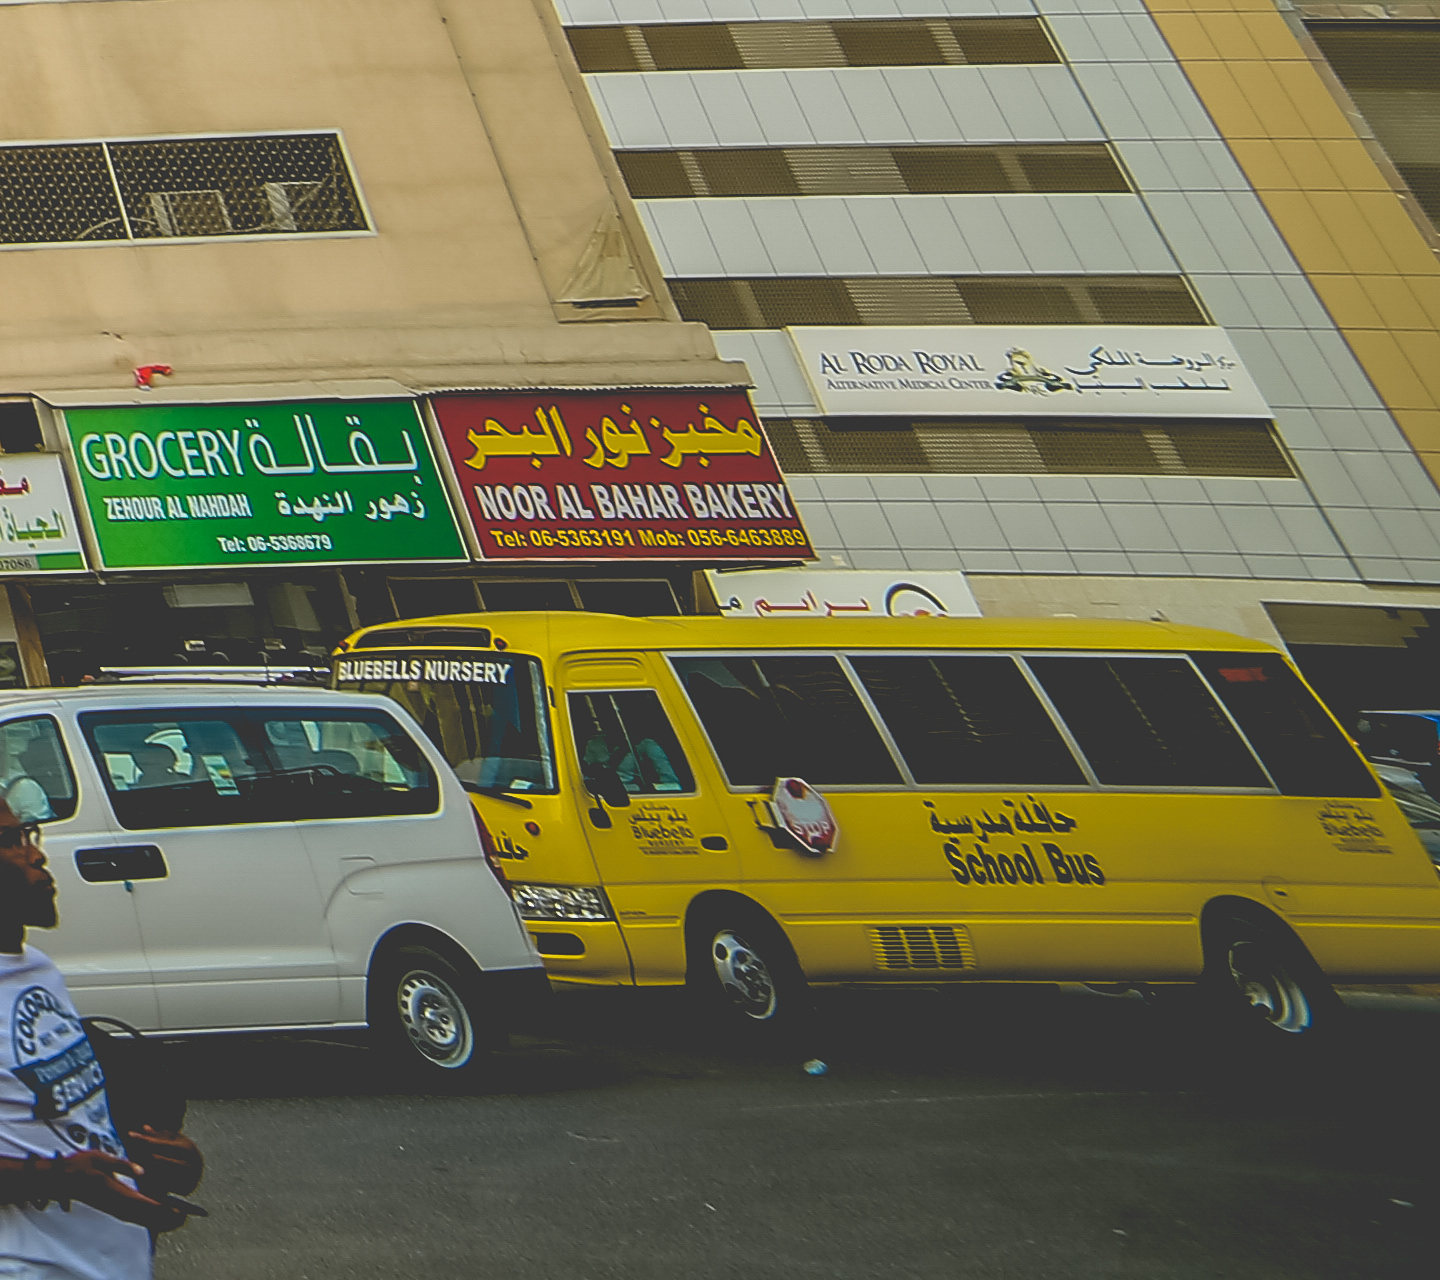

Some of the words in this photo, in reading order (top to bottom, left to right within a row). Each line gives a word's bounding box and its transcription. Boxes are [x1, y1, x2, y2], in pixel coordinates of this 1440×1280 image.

[82, 429, 244, 478] GROCERY
[244, 413, 424, 485] بقالة
[464, 405, 571, 470] البحر
[583, 403, 651, 468] نور
[650, 403, 762, 468] مخبز
[104, 496, 166, 520] ZEHOUR
[166, 496, 188, 519] AL
[188, 494, 252, 518] NAHDAH
[274, 491, 354, 522] النهدة
[366, 490, 426, 520] زهور
[474, 486, 556, 520] NOOR
[556, 486, 594, 519] AL
[590, 485, 688, 519] BAHAR
[683, 484, 793, 518] BAKERY
[1, 506, 66, 548] الحياة
[217, 537, 246, 552] Tel:
[490, 531, 527, 547] Tel:
[531, 530, 633, 547] 06-5363191
[639, 530, 685, 546] Mob:
[688, 529, 806, 546] 056-6463889
[338, 659, 423, 681] BLUEBELLS
[424, 660, 512, 685] NURSERY
[922, 799, 1015, 845] مدرسية
[1002, 793, 1078, 834] حافلة
[943, 842, 1045, 885] School
[1041, 841, 1106, 886] Bus
